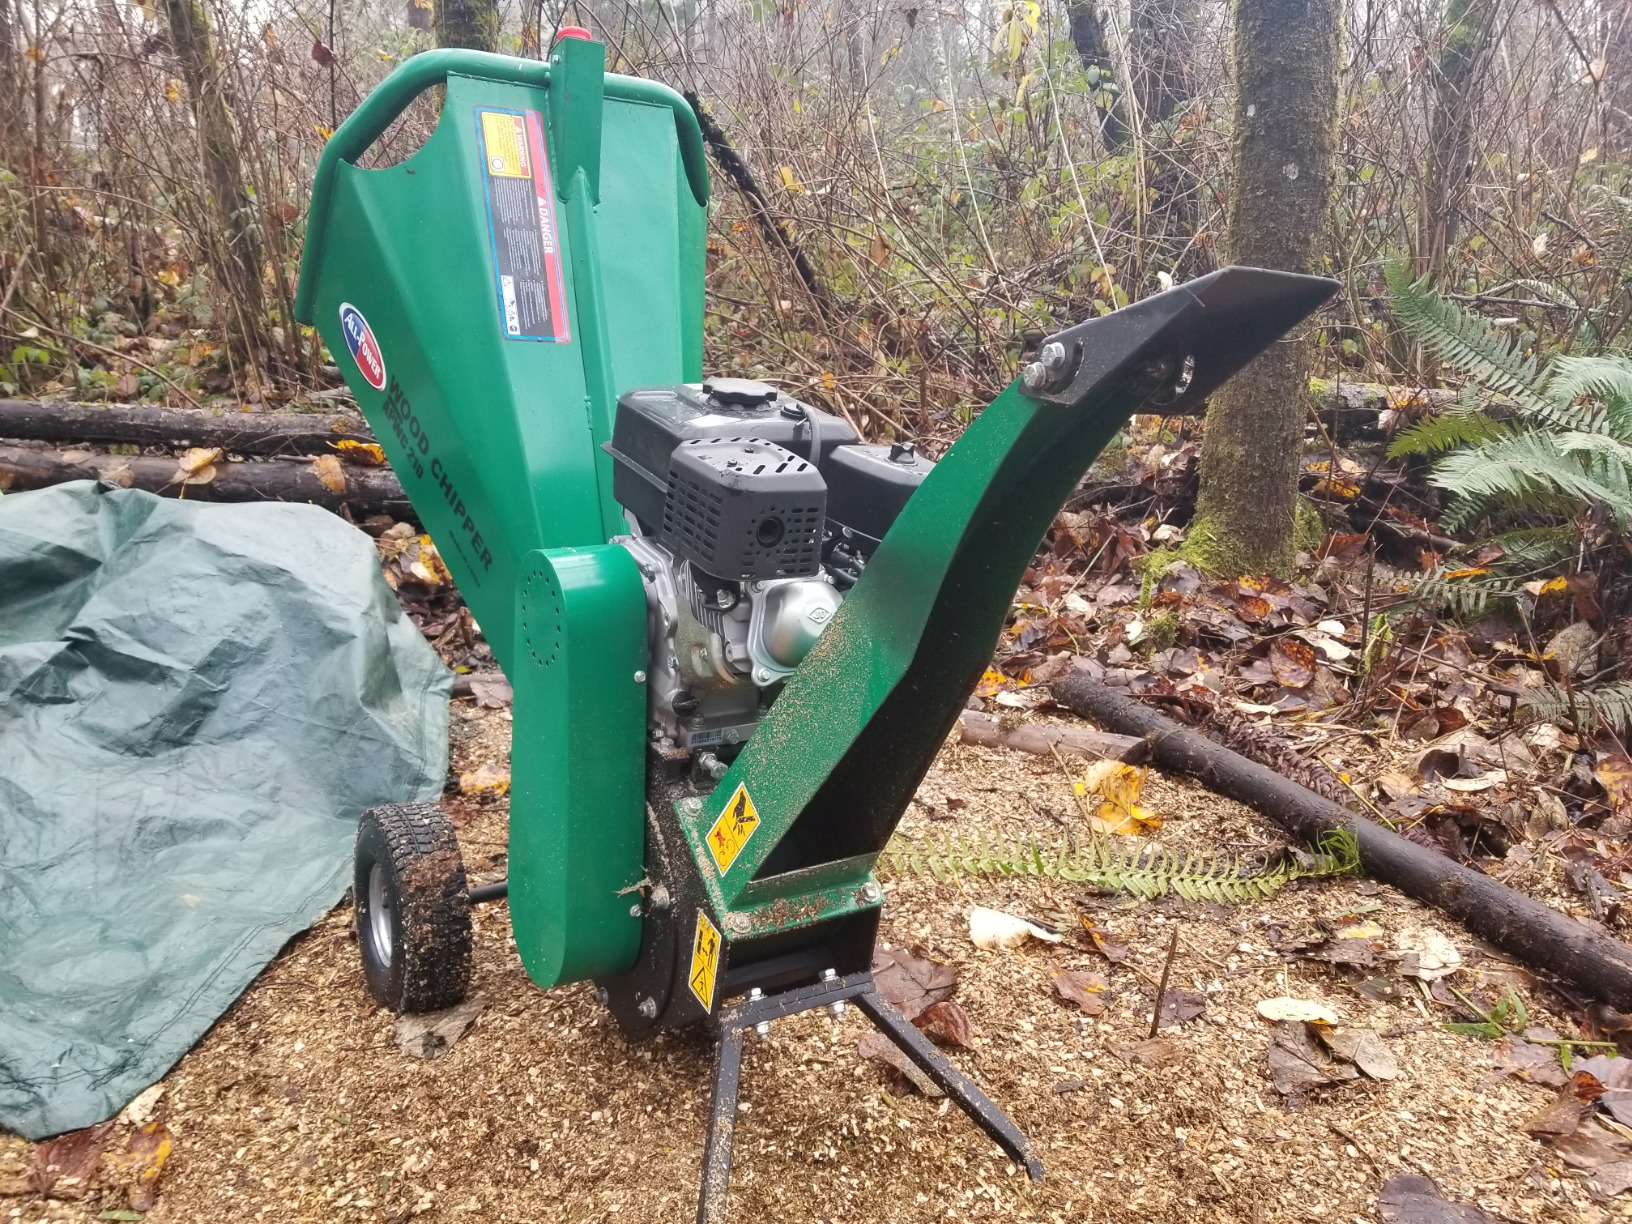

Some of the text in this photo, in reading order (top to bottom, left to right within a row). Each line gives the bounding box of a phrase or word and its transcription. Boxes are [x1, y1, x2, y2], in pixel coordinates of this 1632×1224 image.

[515, 133, 527, 168] WARNING
[540, 207, 554, 254] DANGER
[344, 313, 381, 380] ALL-POWER
[382, 399, 424, 479] APWC 210
[389, 374, 430, 456] WOOD
[431, 457, 493, 573] CHIPPER
